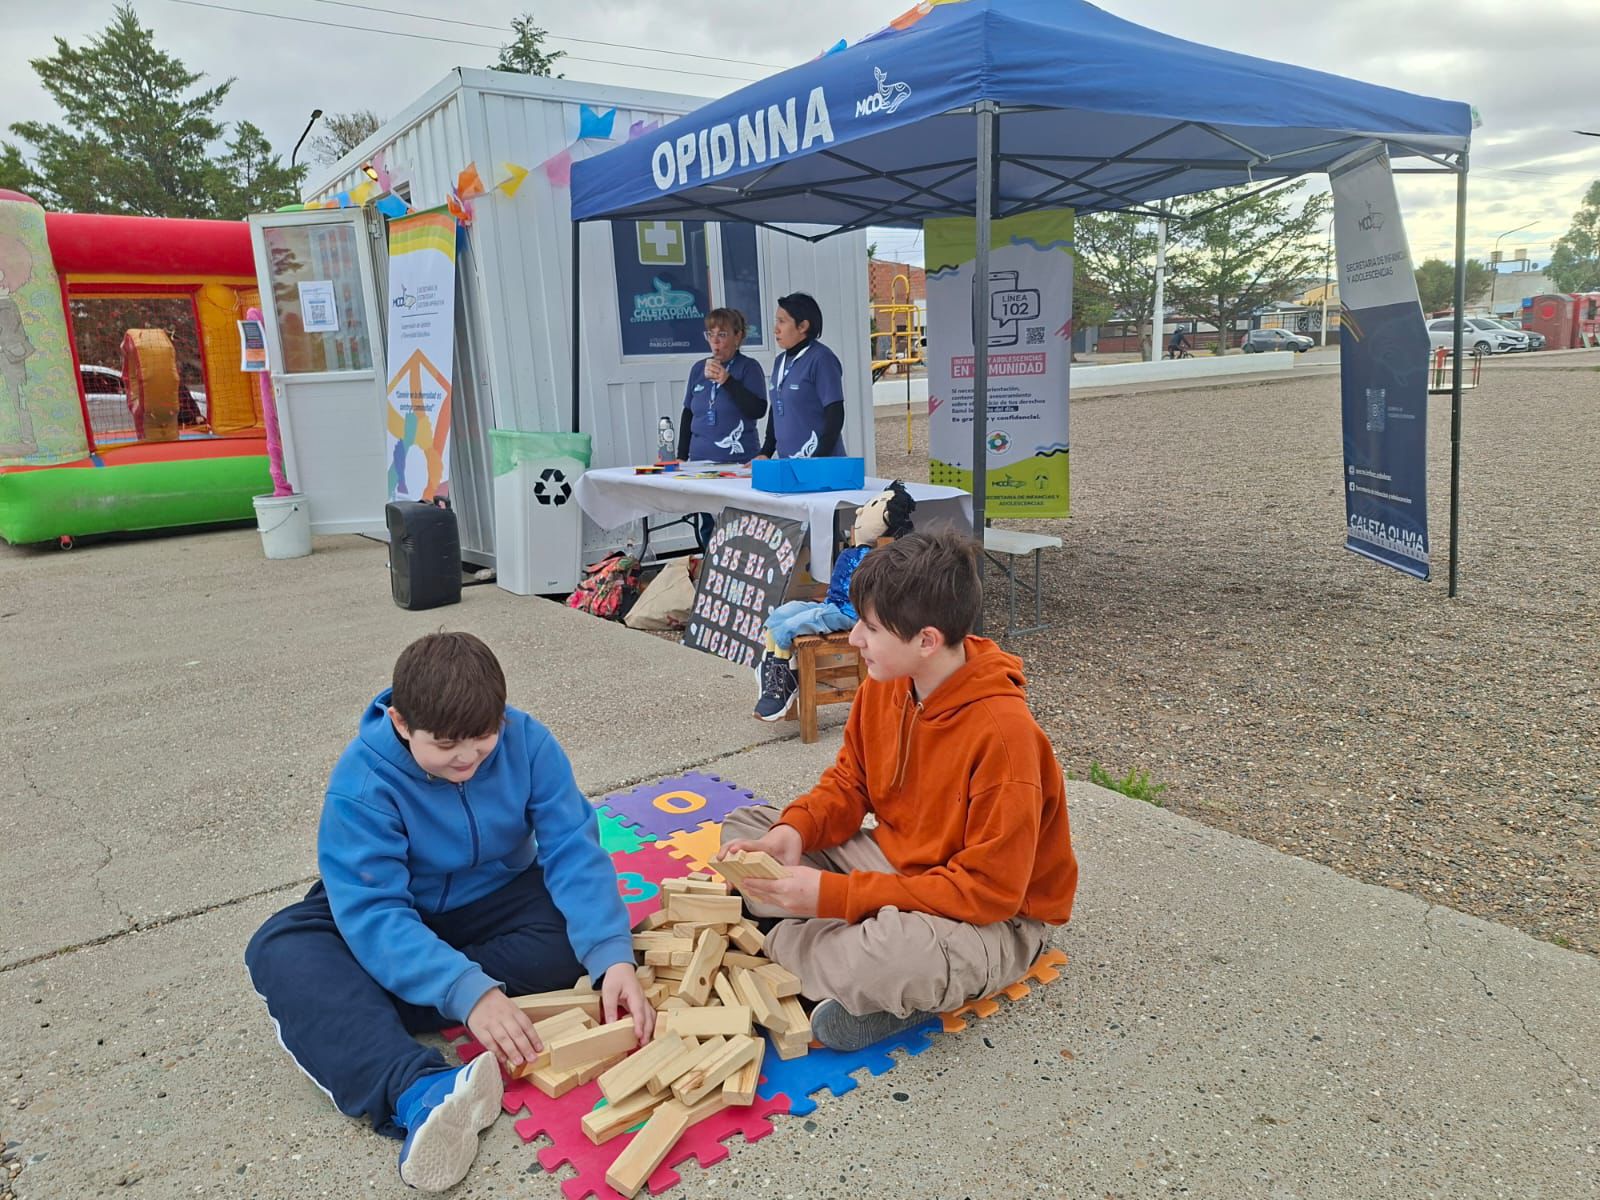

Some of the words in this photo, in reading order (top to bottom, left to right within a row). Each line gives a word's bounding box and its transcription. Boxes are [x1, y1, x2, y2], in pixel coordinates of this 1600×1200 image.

[855, 92, 882, 118] MCO
[652, 86, 834, 191] OPIDNNA
[633, 307, 668, 319] CALETA
[669, 305, 699, 316] OLIVIA
[638, 295, 664, 308] MCO
[1002, 294, 1027, 302] LÍNEA
[1002, 303, 1028, 316] 102
[953, 365, 969, 376] EN
[972, 362, 1042, 375] MUNIDAD
[992, 353, 1042, 363] ADOLESCENCIAS
[708, 515, 796, 575] COMPRENDER
[1350, 514, 1386, 540] CALETA
[1388, 526, 1424, 553] OLIVIA
[720, 546, 742, 571] ES
[744, 553, 765, 579] EL
[705, 568, 765, 612] PRIMER
[694, 593, 730, 627] PASO
[732, 609, 768, 647] PARA
[696, 624, 756, 666] INCLUIR
